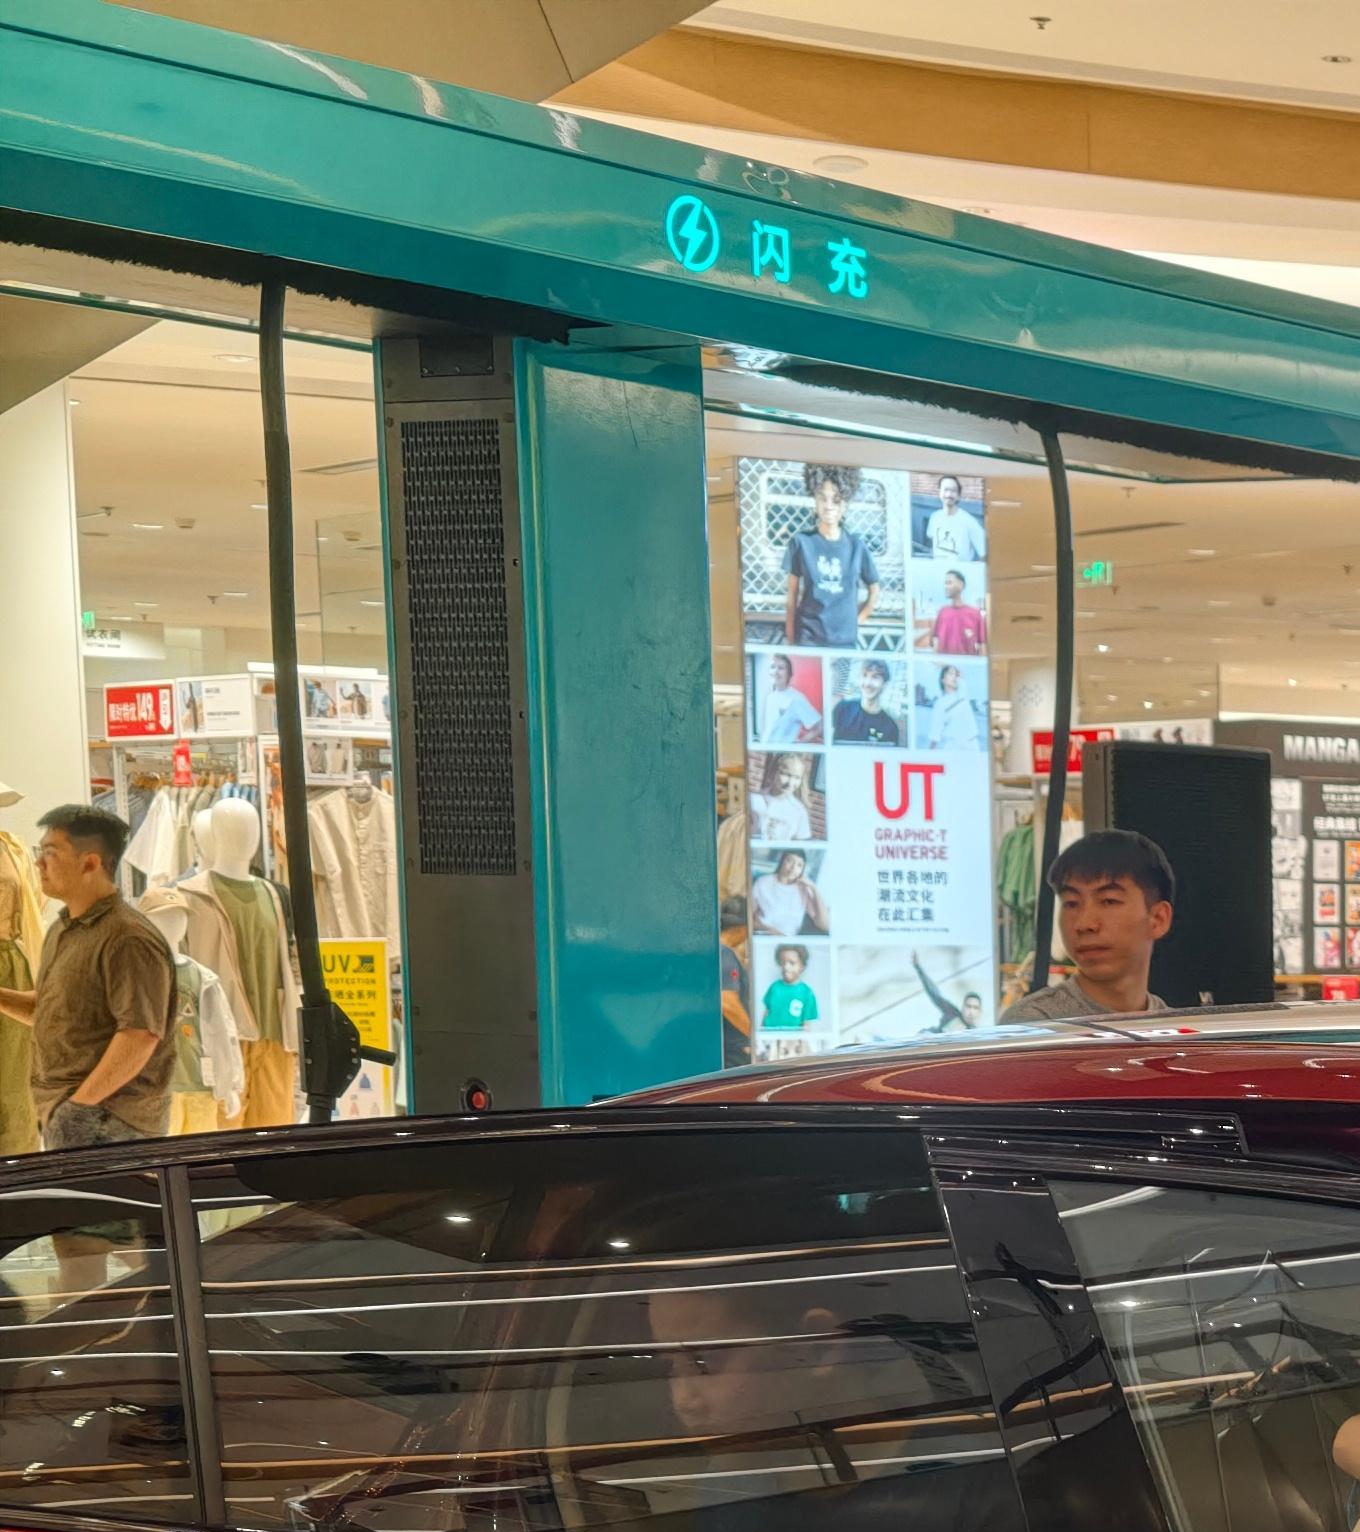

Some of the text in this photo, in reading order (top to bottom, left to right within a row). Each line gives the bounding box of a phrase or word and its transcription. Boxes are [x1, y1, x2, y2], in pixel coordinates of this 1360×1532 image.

[752, 219, 868, 298] 闪充
[1283, 734, 1360, 763] MANGA
[873, 761, 946, 822] UT
[875, 845, 948, 861] UNIVERSE
[877, 870, 948, 886] 世界各地的
[878, 888, 934, 903] 潮流文化
[878, 907, 934, 921] 在此汇集
[323, 954, 350, 973] UV
[332, 989, 376, 1001] 晒全系列
